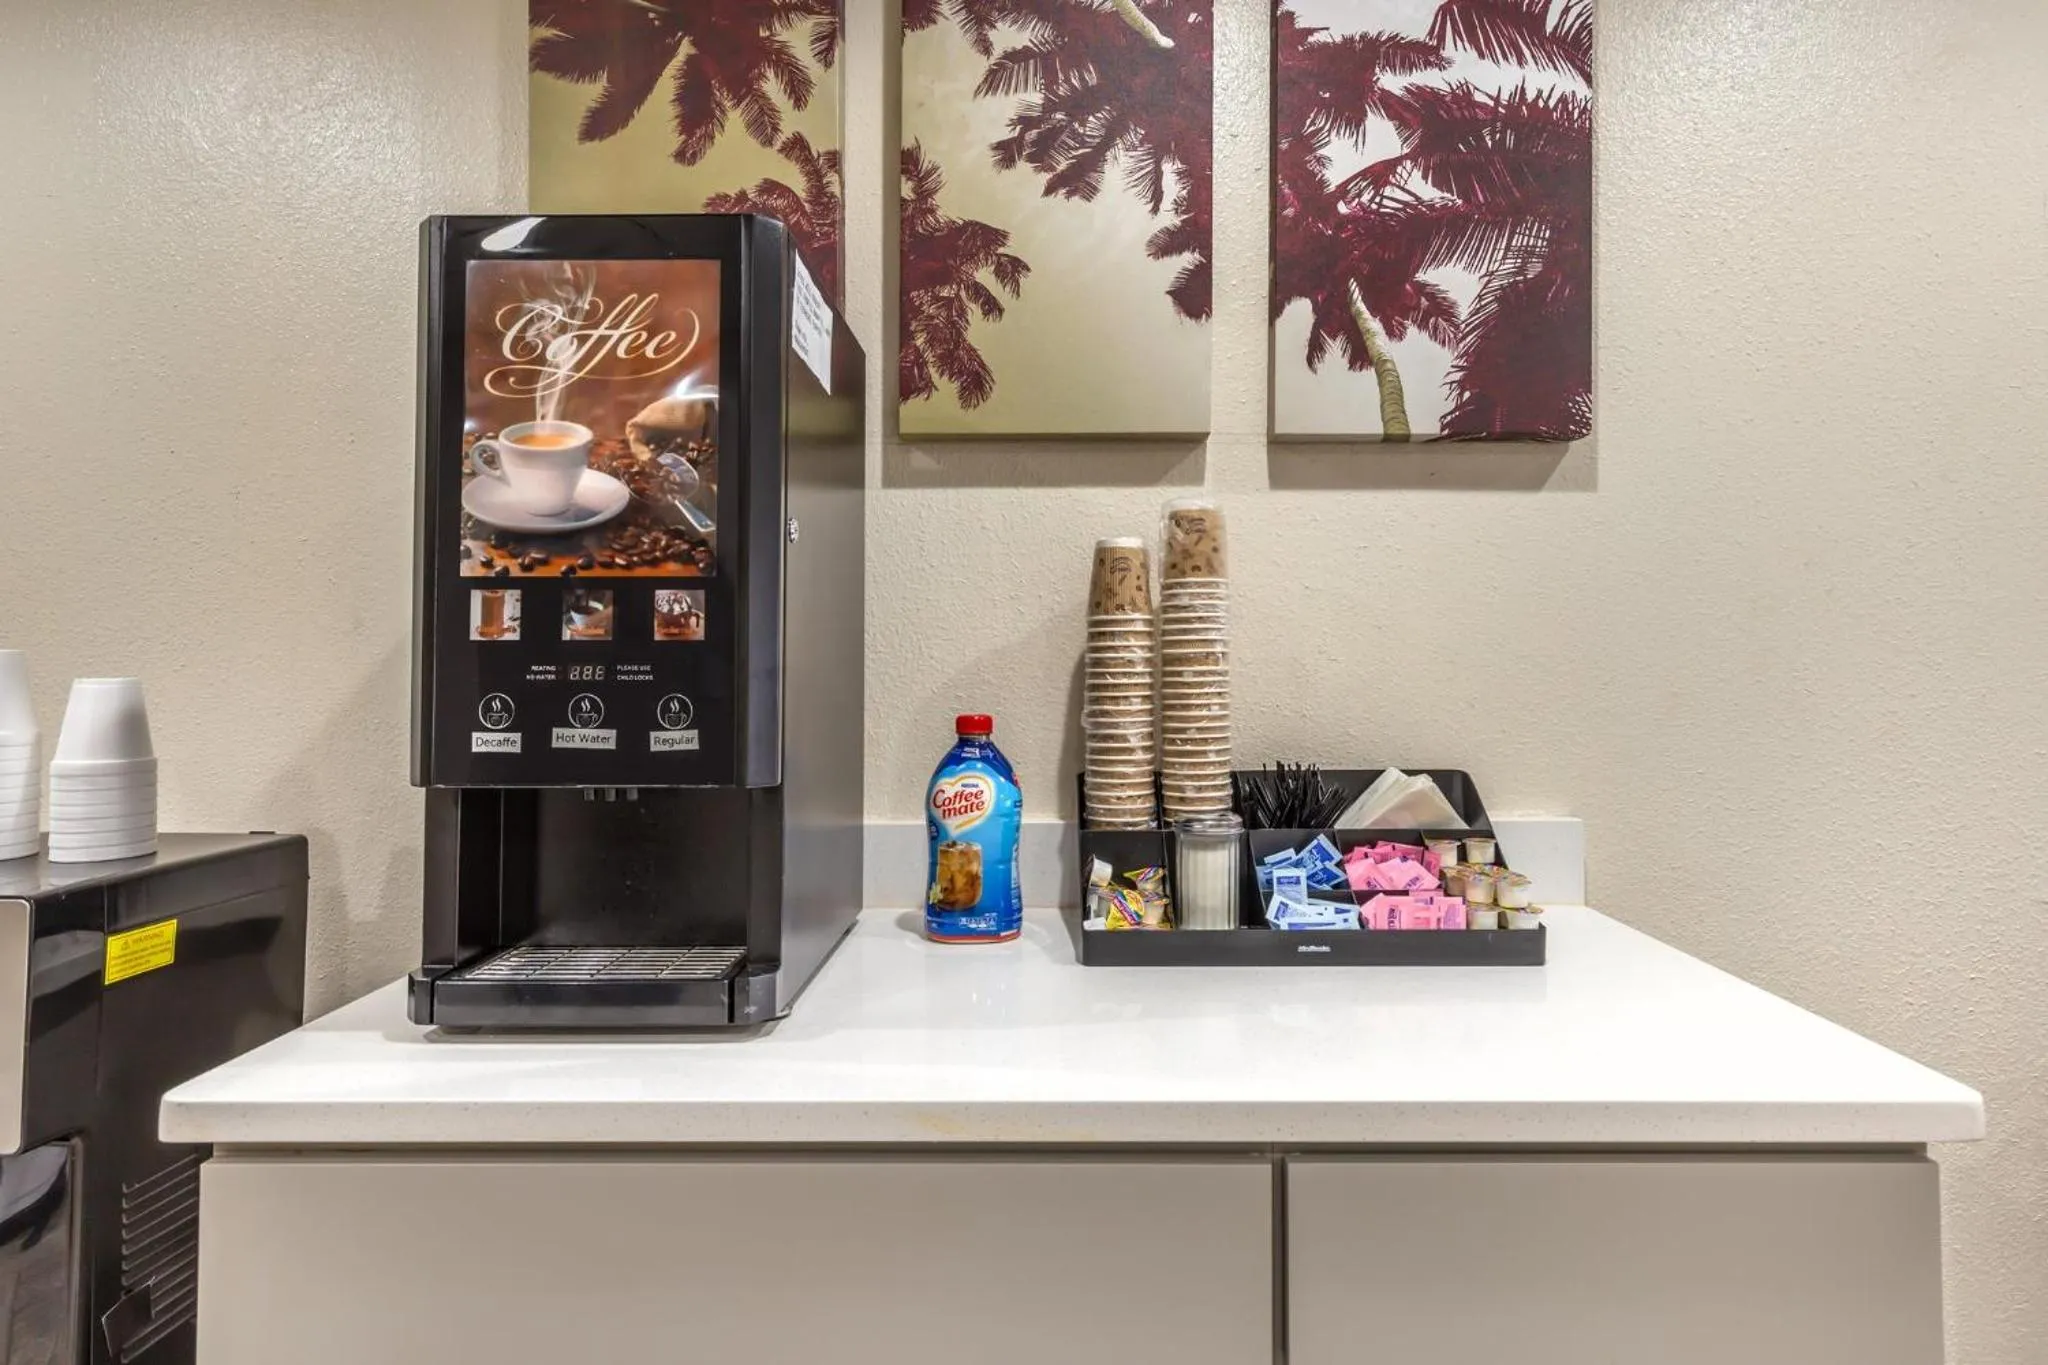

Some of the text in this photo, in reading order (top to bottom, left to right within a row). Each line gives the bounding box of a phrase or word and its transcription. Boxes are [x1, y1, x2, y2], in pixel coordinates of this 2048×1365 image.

[484, 293, 700, 397] Coffee
[475, 736, 518, 748] Decaffe
[556, 733, 613, 745] Hot Water
[653, 735, 696, 748] Regular
[932, 788, 985, 809] Coffee
[942, 800, 986, 820] mate
